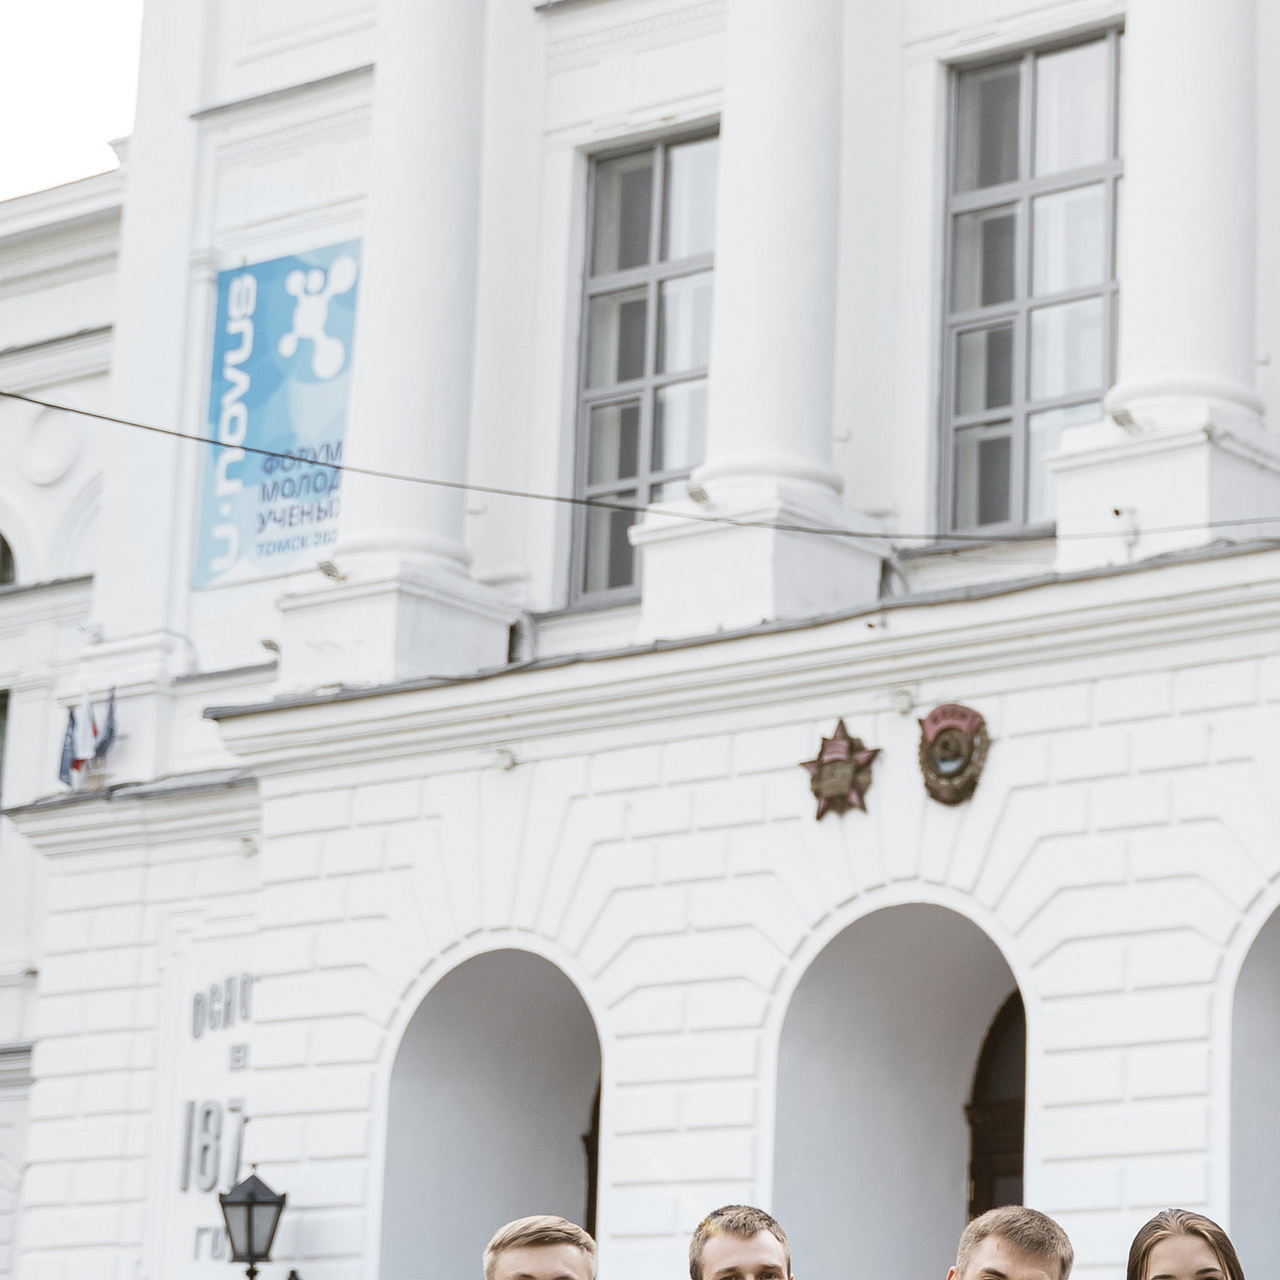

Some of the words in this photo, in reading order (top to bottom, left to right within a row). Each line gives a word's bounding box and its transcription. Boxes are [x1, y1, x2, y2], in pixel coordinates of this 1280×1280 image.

[263, 442, 342, 475] ФОРУМ
[261, 468, 339, 502] МОЛОД
[256, 498, 340, 534] УЧЕНЫ
[257, 534, 308, 557] ТОМСК
[313, 529, 338, 546] 202
[180, 1099, 246, 1192] 187
[195, 1227, 228, 1259] ГО
